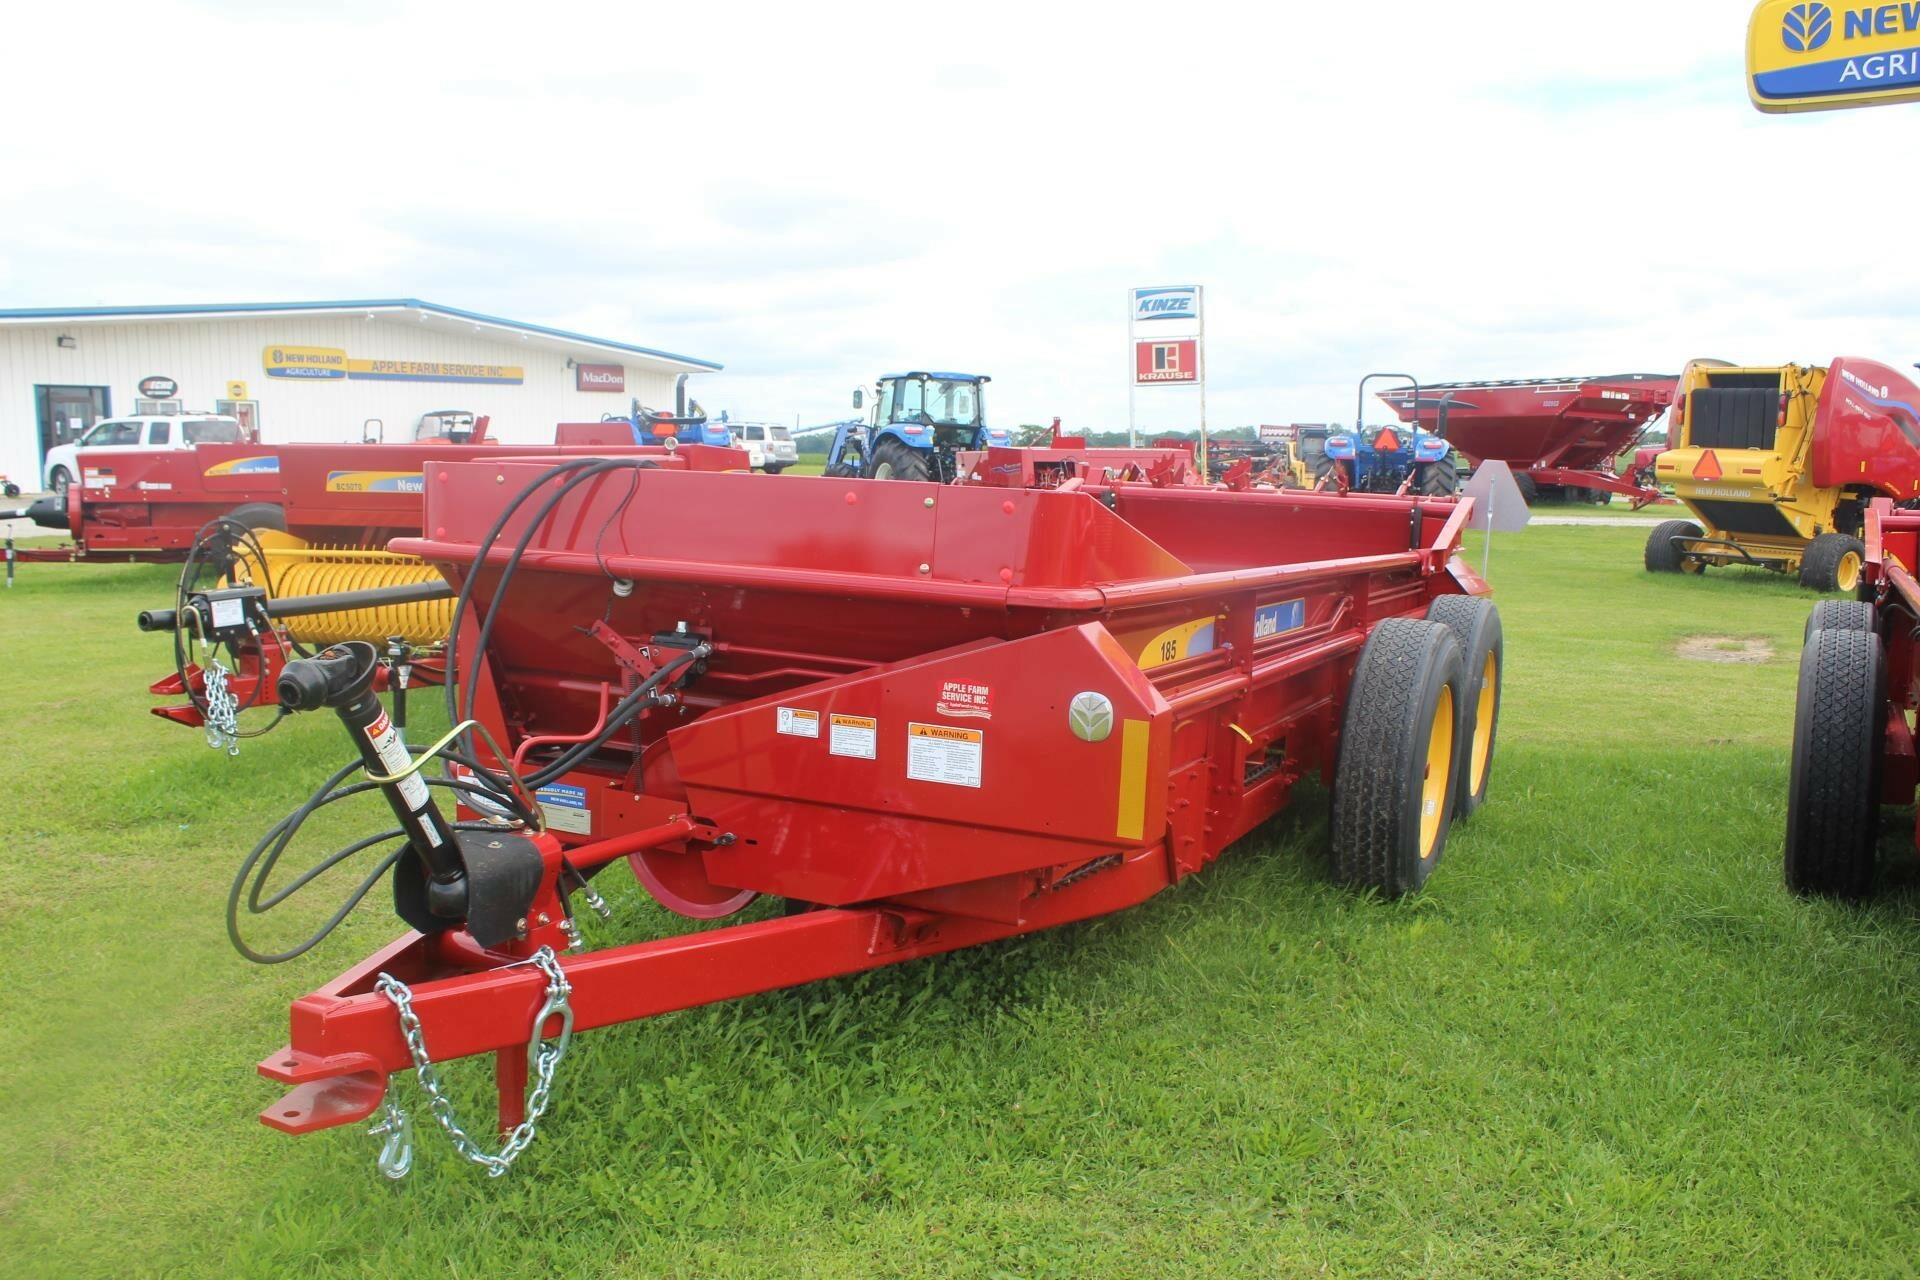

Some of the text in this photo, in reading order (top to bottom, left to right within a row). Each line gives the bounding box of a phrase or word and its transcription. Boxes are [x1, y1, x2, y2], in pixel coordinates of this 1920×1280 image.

[1839, 52, 1917, 83] AGRI
[1138, 297, 1191, 312] KINZE
[285, 354, 342, 364] NEW HOLLAND
[285, 368, 330, 377] AGRICULTURE
[372, 361, 407, 373] APPLE
[410, 362, 439, 374] FARM
[442, 364, 484, 376] SERVICE
[583, 372, 623, 384] MacDon
[1139, 371, 1193, 380] KRAUSE
[1841, 368, 1880, 398] NEW HOLLAND
[397, 479, 423, 491] New
[1696, 487, 1751, 497] NEW HOLLAND
[1254, 610, 1277, 638] olland
[1160, 639, 1177, 662] 185
[943, 682, 989, 695] APPLE FARM
[942, 691, 989, 704] SERVICE INC.
[842, 719, 871, 727] WARNING
[931, 728, 968, 740] WARNING
